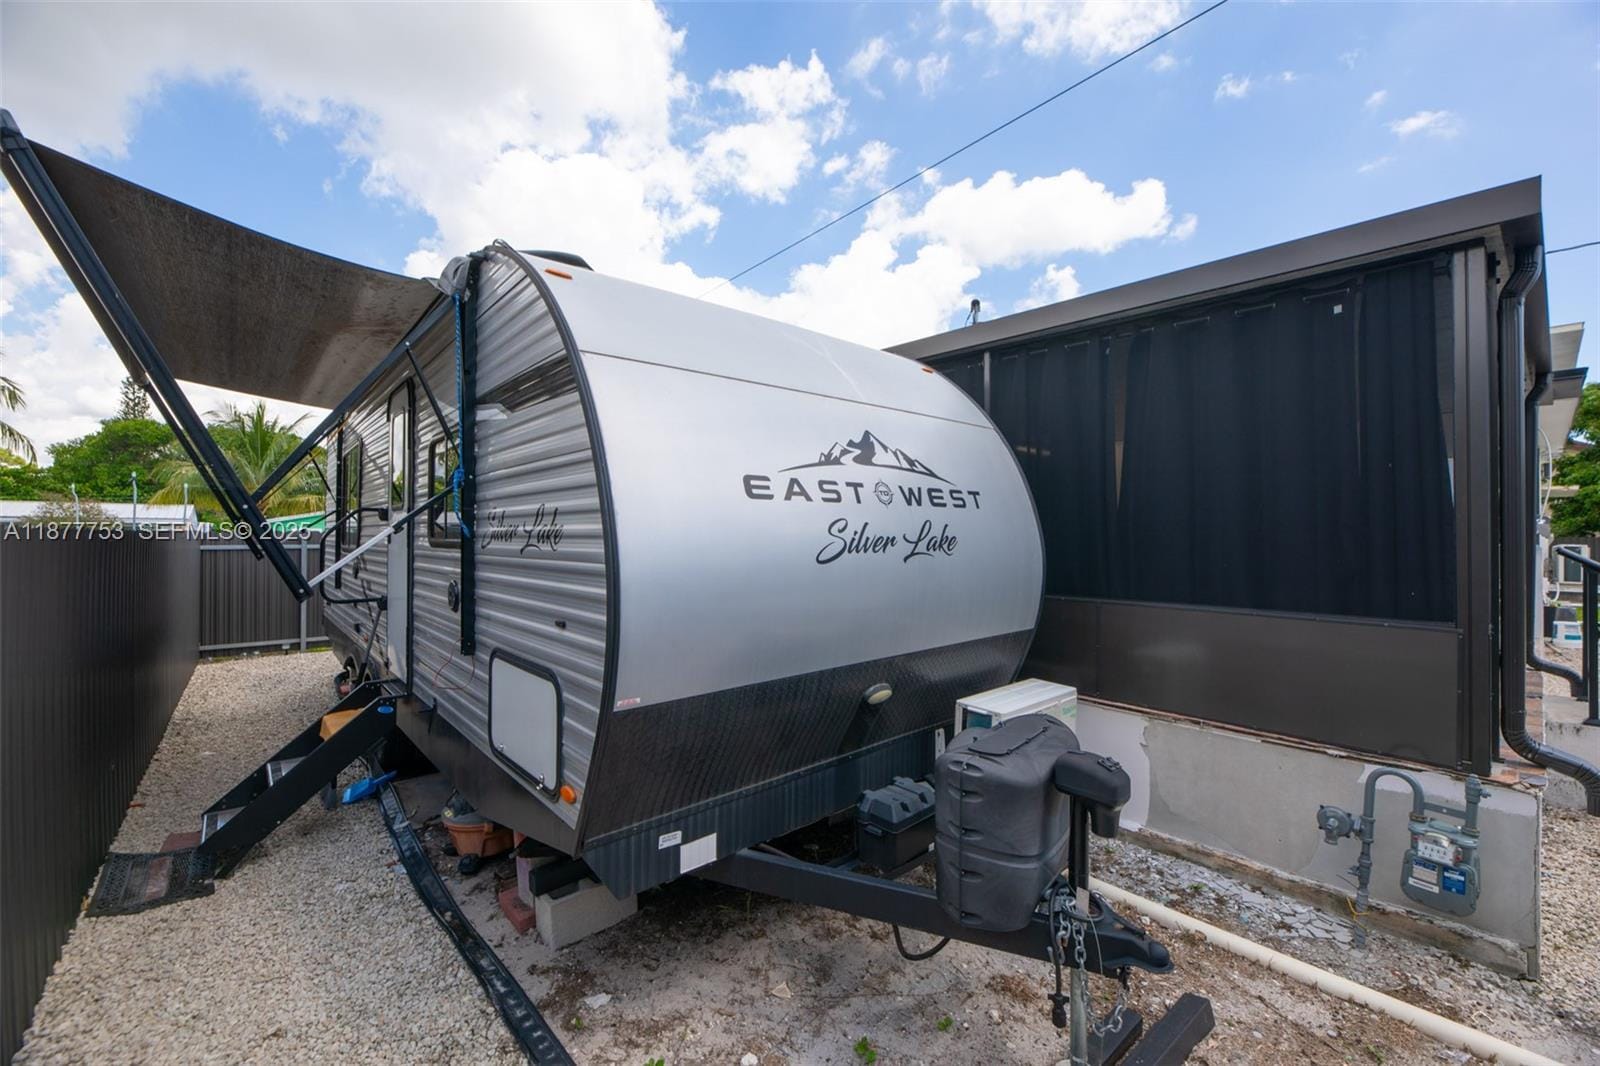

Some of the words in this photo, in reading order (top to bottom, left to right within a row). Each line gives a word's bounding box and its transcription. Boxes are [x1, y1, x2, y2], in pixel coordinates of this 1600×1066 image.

[742, 474, 864, 505] EAST
[898, 485, 982, 510] WEST
[481, 507, 519, 549] Silver
[519, 503, 565, 556] Lake
[815, 518, 897, 565] Silver
[902, 519, 959, 564] Lake
